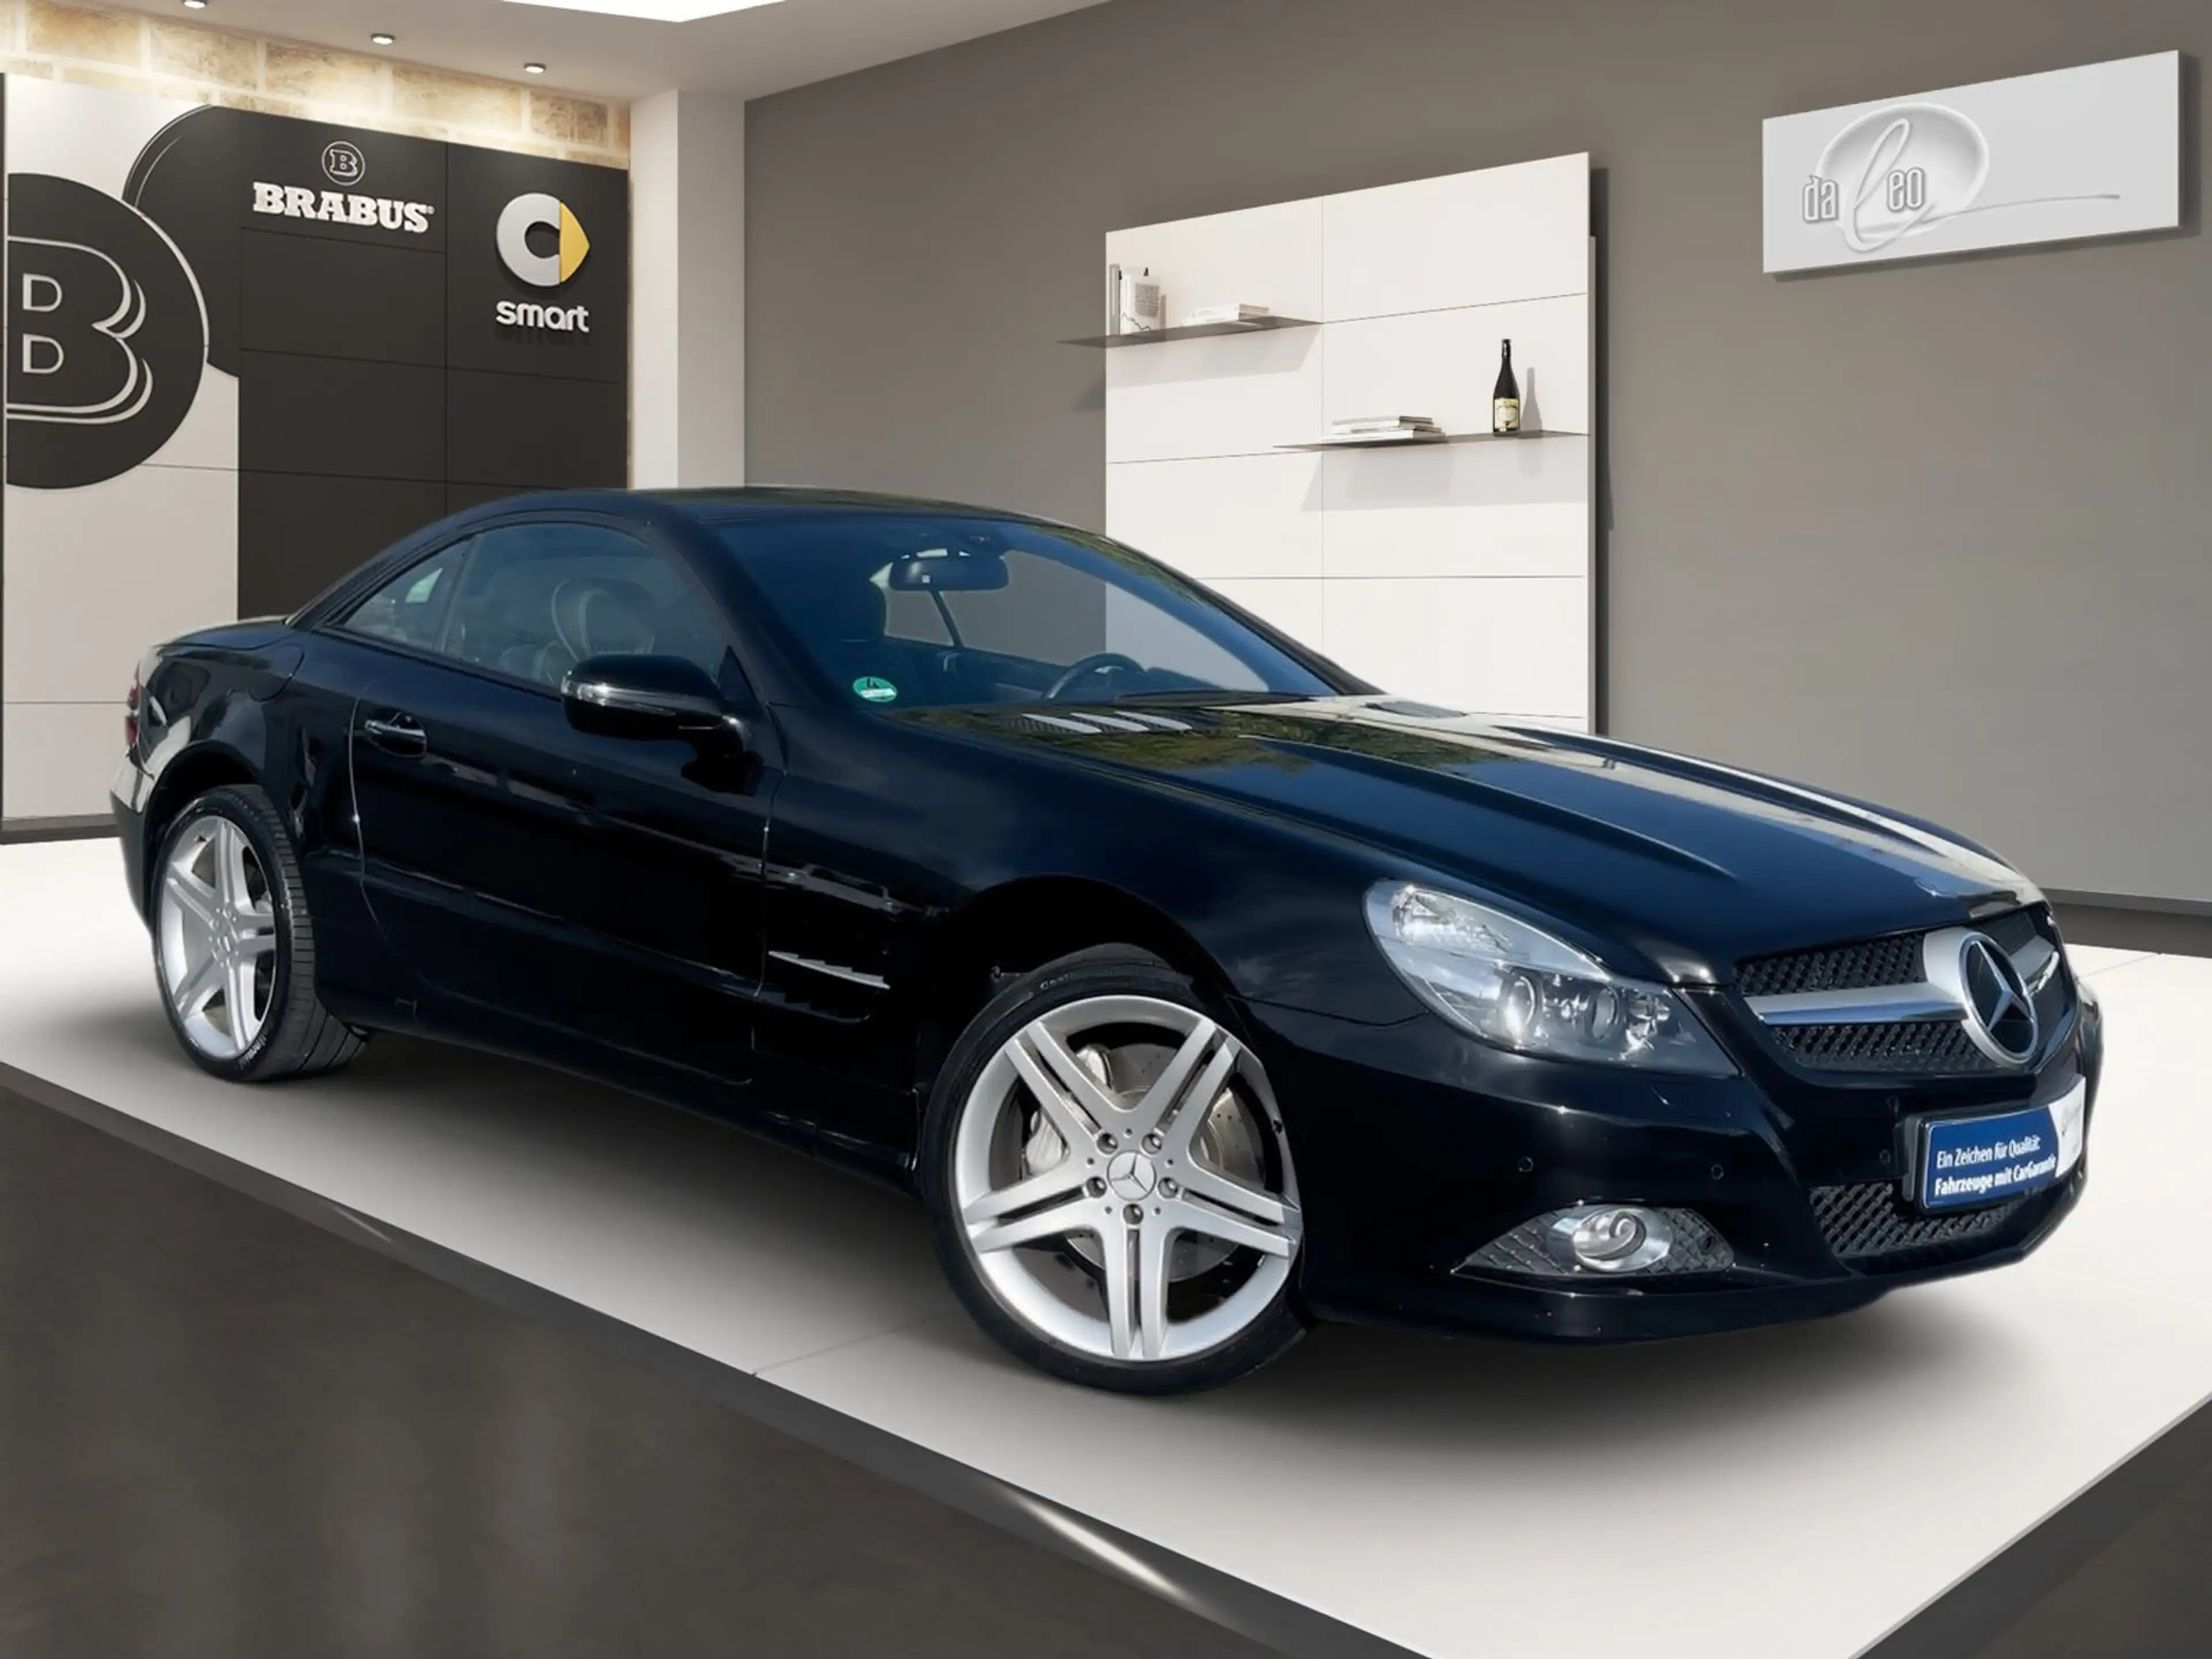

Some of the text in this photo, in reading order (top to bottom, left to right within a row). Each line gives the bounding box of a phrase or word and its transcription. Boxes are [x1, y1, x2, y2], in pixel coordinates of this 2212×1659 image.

[496, 300, 589, 333] smart
[1937, 1150, 1953, 1169] Ein
[1955, 1145, 1993, 1166] Zeichen
[1994, 1141, 2008, 1161] für
[1935, 1174, 1993, 1196] Fahrzeuge
[1995, 1166, 2012, 1186] mit
